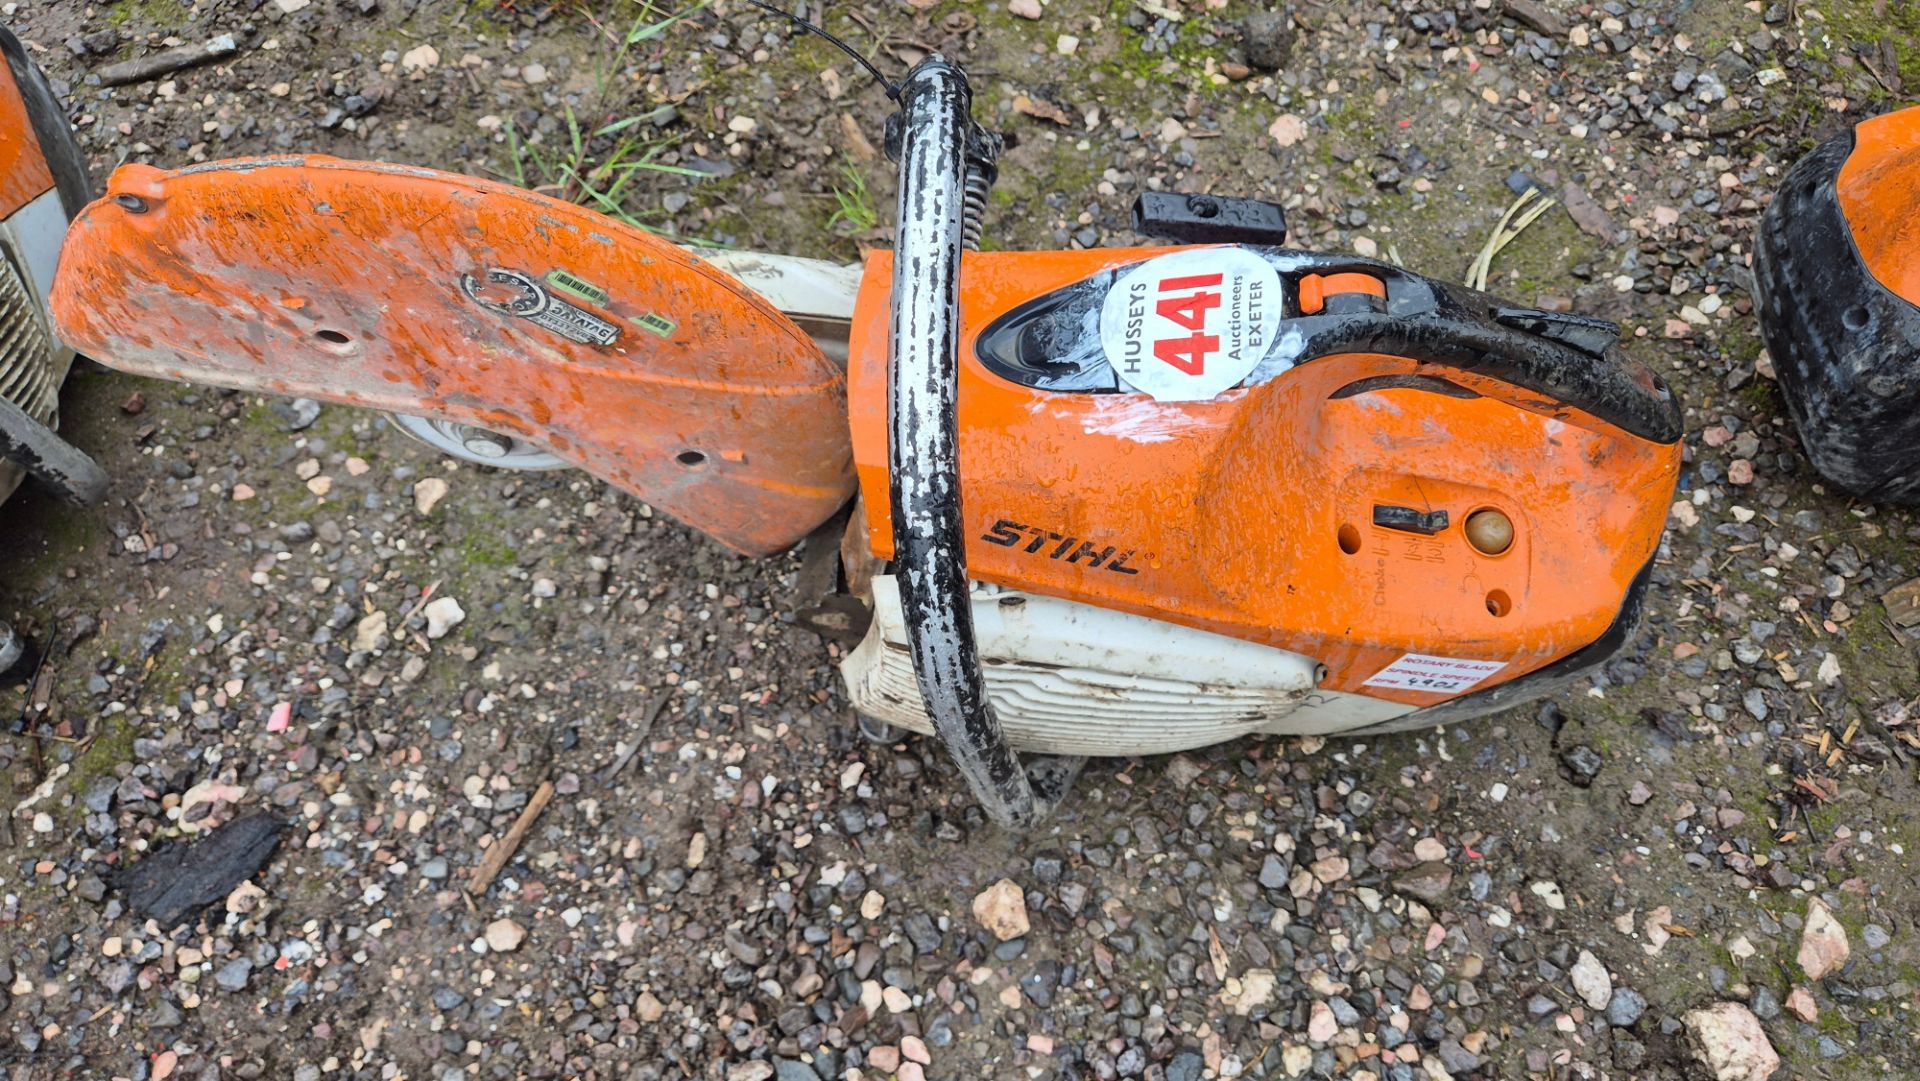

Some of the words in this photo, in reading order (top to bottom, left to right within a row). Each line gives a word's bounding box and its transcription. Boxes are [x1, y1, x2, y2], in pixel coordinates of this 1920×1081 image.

[1124, 283, 1146, 373] HUSSEYS
[1154, 272, 1223, 376] 441
[1228, 275, 1243, 360] Auctioneers
[1249, 280, 1263, 347] EXETER
[980, 519, 1139, 575] STIHL
[1386, 667, 1438, 678] SPINDLE
[1440, 673, 1481, 682] SPEED
[1402, 657, 1452, 668] ROTARY
[1455, 663, 1498, 672] BLADE
